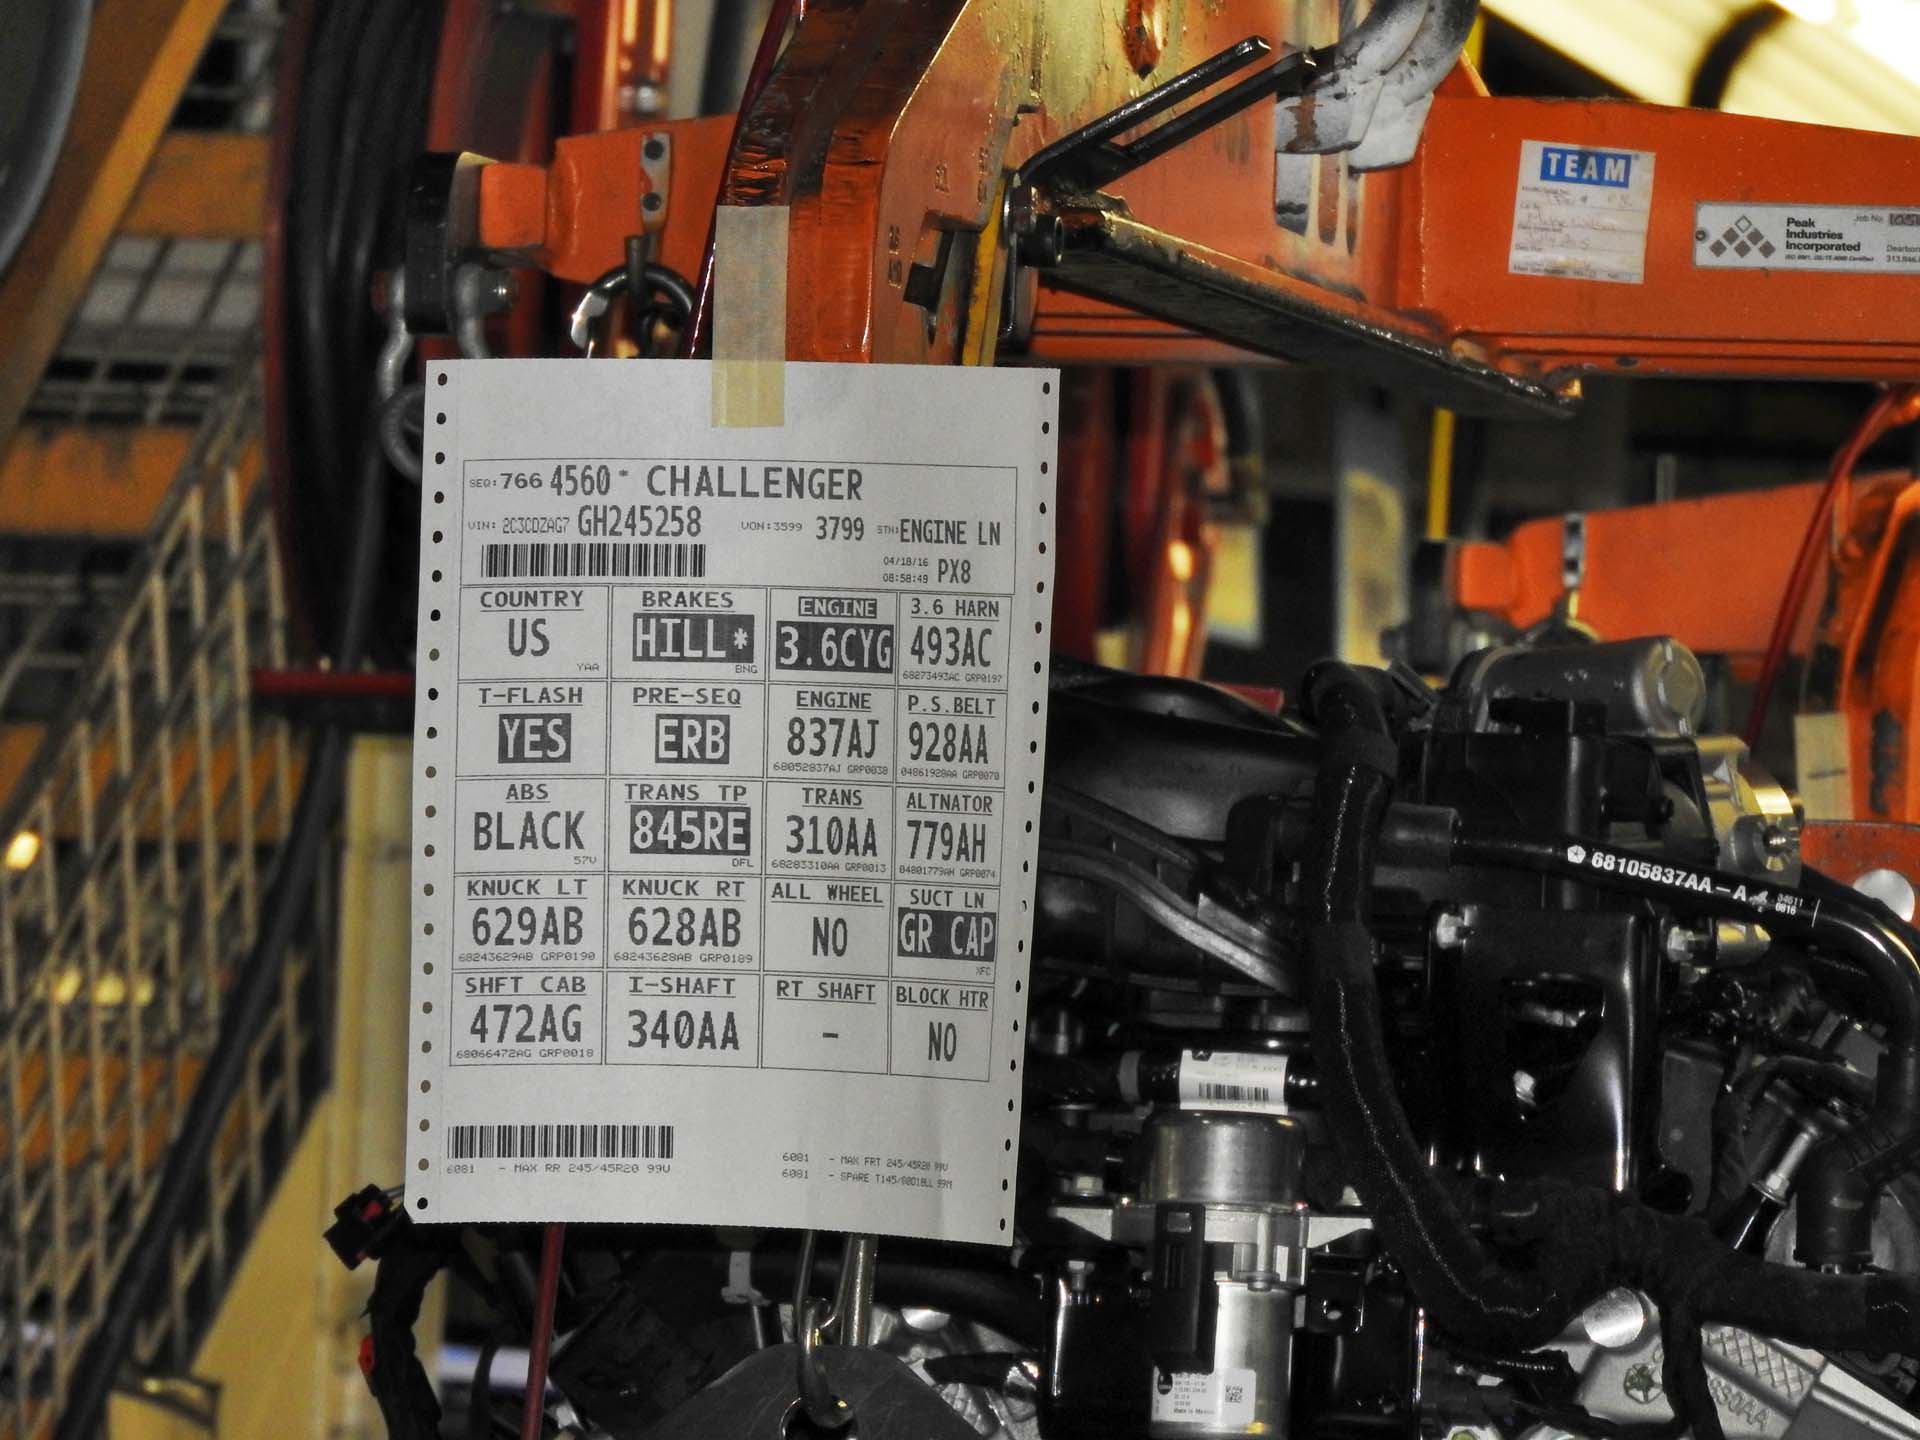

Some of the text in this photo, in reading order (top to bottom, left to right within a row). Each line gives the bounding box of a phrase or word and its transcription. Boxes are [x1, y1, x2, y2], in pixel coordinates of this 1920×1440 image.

[1548, 152, 1626, 182] TEAM
[1786, 217, 1815, 228] Peak
[1786, 228, 1843, 240] Industries
[1786, 240, 1861, 252] Incorporated
[469, 464, 863, 501] SEQ: 766 4560 CHALLENGER
[577, 504, 702, 537] GH245258
[815, 516, 865, 541] 3799
[900, 518, 967, 545] ENGINE
[977, 520, 1001, 546] LN
[882, 556, 929, 568] 04/18/16
[937, 557, 972, 585] PX8
[480, 590, 584, 608] COUNTRY
[641, 590, 734, 608] BRAKES
[800, 597, 876, 618] ENGINE
[910, 597, 1000, 618] 3.6 HARN
[508, 617, 550, 657] US
[779, 625, 891, 670] 3.6CYG
[910, 624, 992, 667] 493AC
[735, 664, 758, 674] BNG
[479, 687, 583, 705] T-FLASH
[632, 686, 742, 705] PRE-SEQ
[796, 690, 872, 710] ENGINE
[907, 694, 996, 715] P.S.BELT
[501, 717, 567, 759] YES
[658, 718, 726, 760] ERB
[787, 716, 880, 759] 837AJ
[908, 720, 989, 765] 928AA
[506, 783, 549, 800] ABS
[625, 783, 747, 802] TRANS TP
[802, 787, 863, 806] TRANS
[906, 792, 993, 813] ALTNATOR
[473, 810, 585, 851] BLACK
[633, 808, 747, 851] 845RE
[786, 814, 878, 858] 310AA
[906, 819, 987, 864] 779AH
[467, 879, 588, 896] KNUCK LT
[1592, 851, 1713, 893] 68105837AA
[1733, 885, 1747, 902] A
[622, 879, 746, 897] KNUCK RT
[771, 882, 883, 904] ALL WHEEL
[910, 888, 985, 909] SUCT LN
[472, 905, 584, 946] 629AB
[628, 905, 741, 947] 628AB
[811, 916, 848, 957] NO
[899, 911, 994, 956] GR CAP
[465, 976, 586, 994] SHFT CAB
[629, 976, 736, 995] I-SHAFT
[776, 979, 876, 1002] RT SHAFT
[895, 985, 989, 1009] BLOCK HTR
[470, 1003, 582, 1043] 472AG
[628, 1009, 740, 1050] 340AA
[927, 1021, 958, 1062] NO
[446, 1164, 475, 1174] 6081
[513, 1163, 538, 1174] MAX
[545, 1163, 561, 1173] RR
[567, 1163, 640, 1174] 245/45R20
[864, 1156, 881, 1167] FRT
[840, 1171, 870, 1183] SPARE
